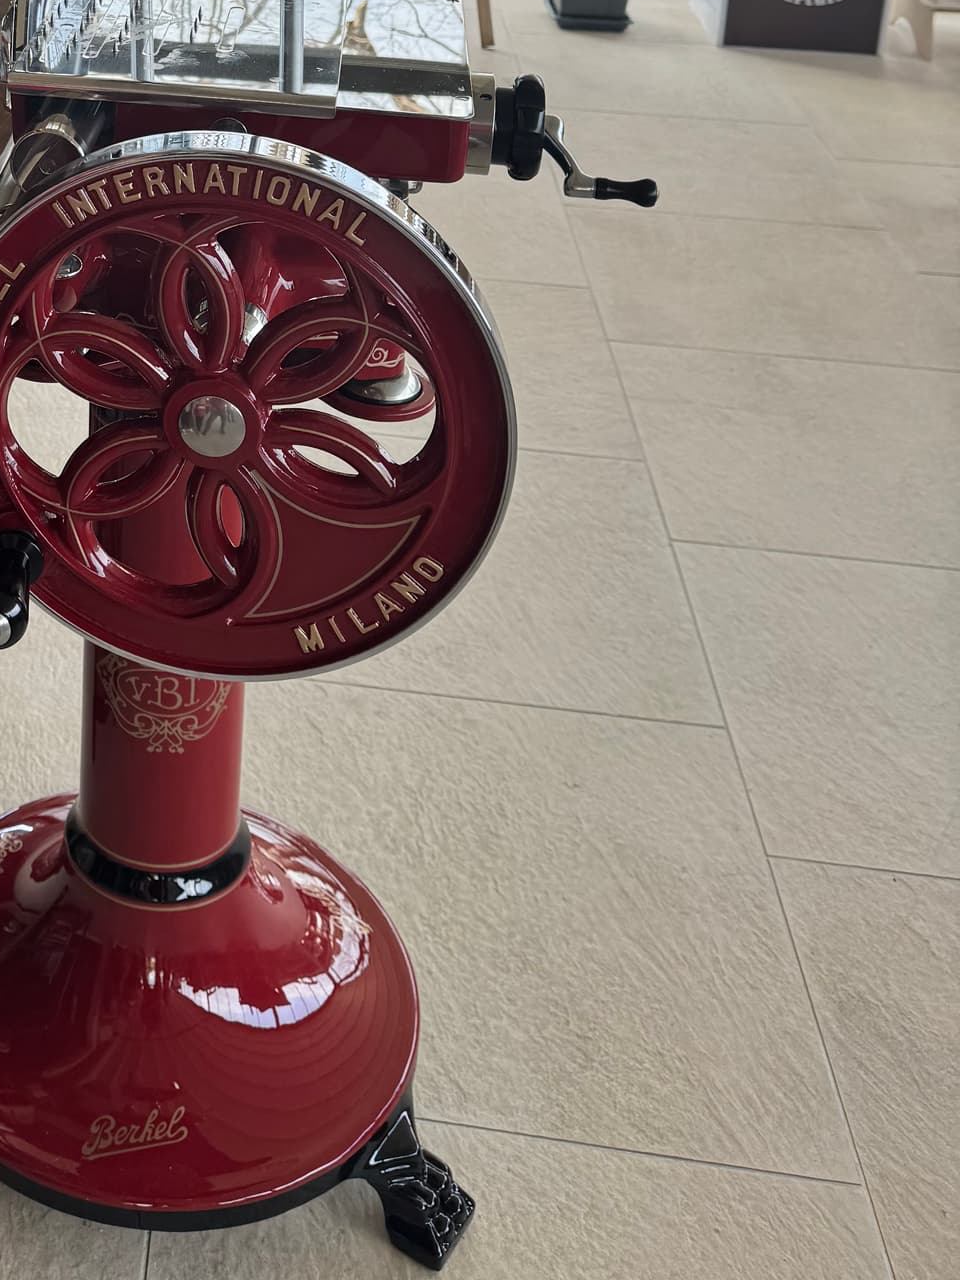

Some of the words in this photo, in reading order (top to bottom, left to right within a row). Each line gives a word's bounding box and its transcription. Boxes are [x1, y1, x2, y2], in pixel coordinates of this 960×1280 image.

[51, 163, 368, 248] INTERNATIONAL
[293, 556, 445, 654] MILANO
[81, 1105, 189, 1160] Berkel
